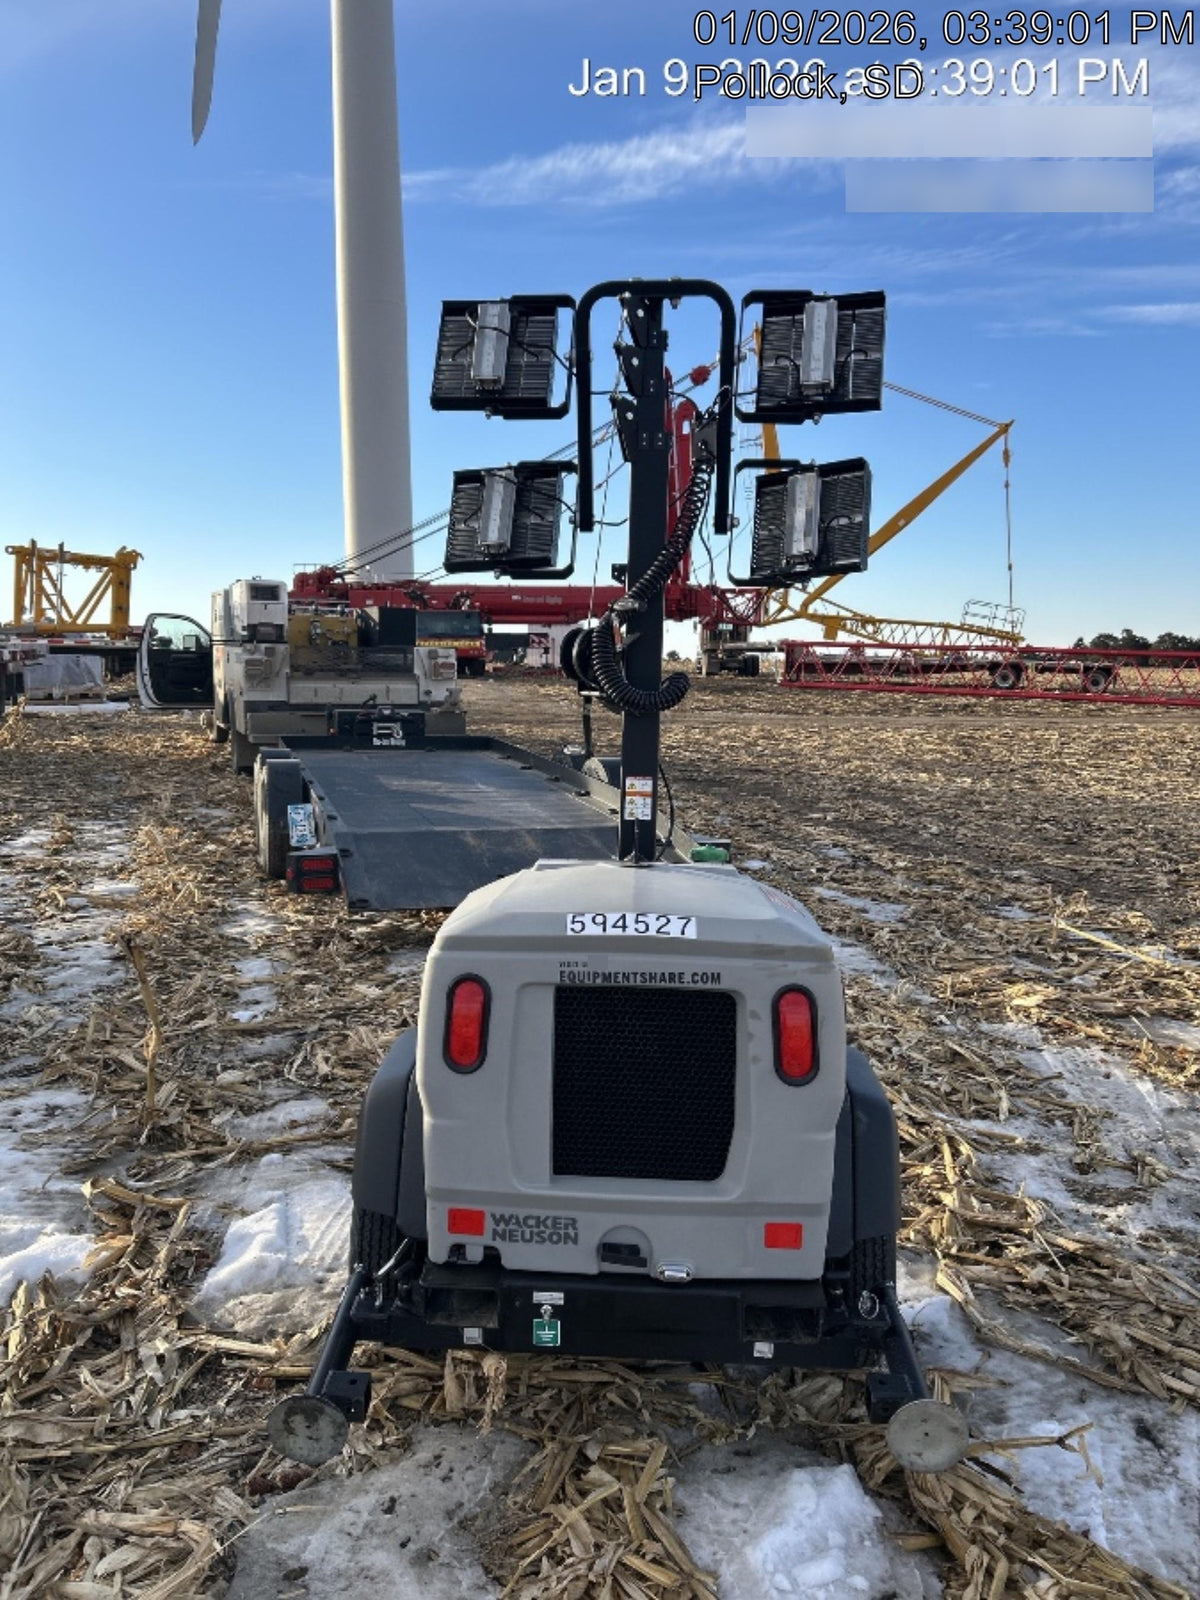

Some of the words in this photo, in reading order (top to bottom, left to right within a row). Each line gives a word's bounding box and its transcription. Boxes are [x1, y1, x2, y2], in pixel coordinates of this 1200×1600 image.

[570, 913, 692, 936] 594527
[559, 970, 721, 986] EQUIPMENTSHARE.COM
[490, 1213, 578, 1231] WACKER
[492, 1229, 579, 1246] NEUSON
